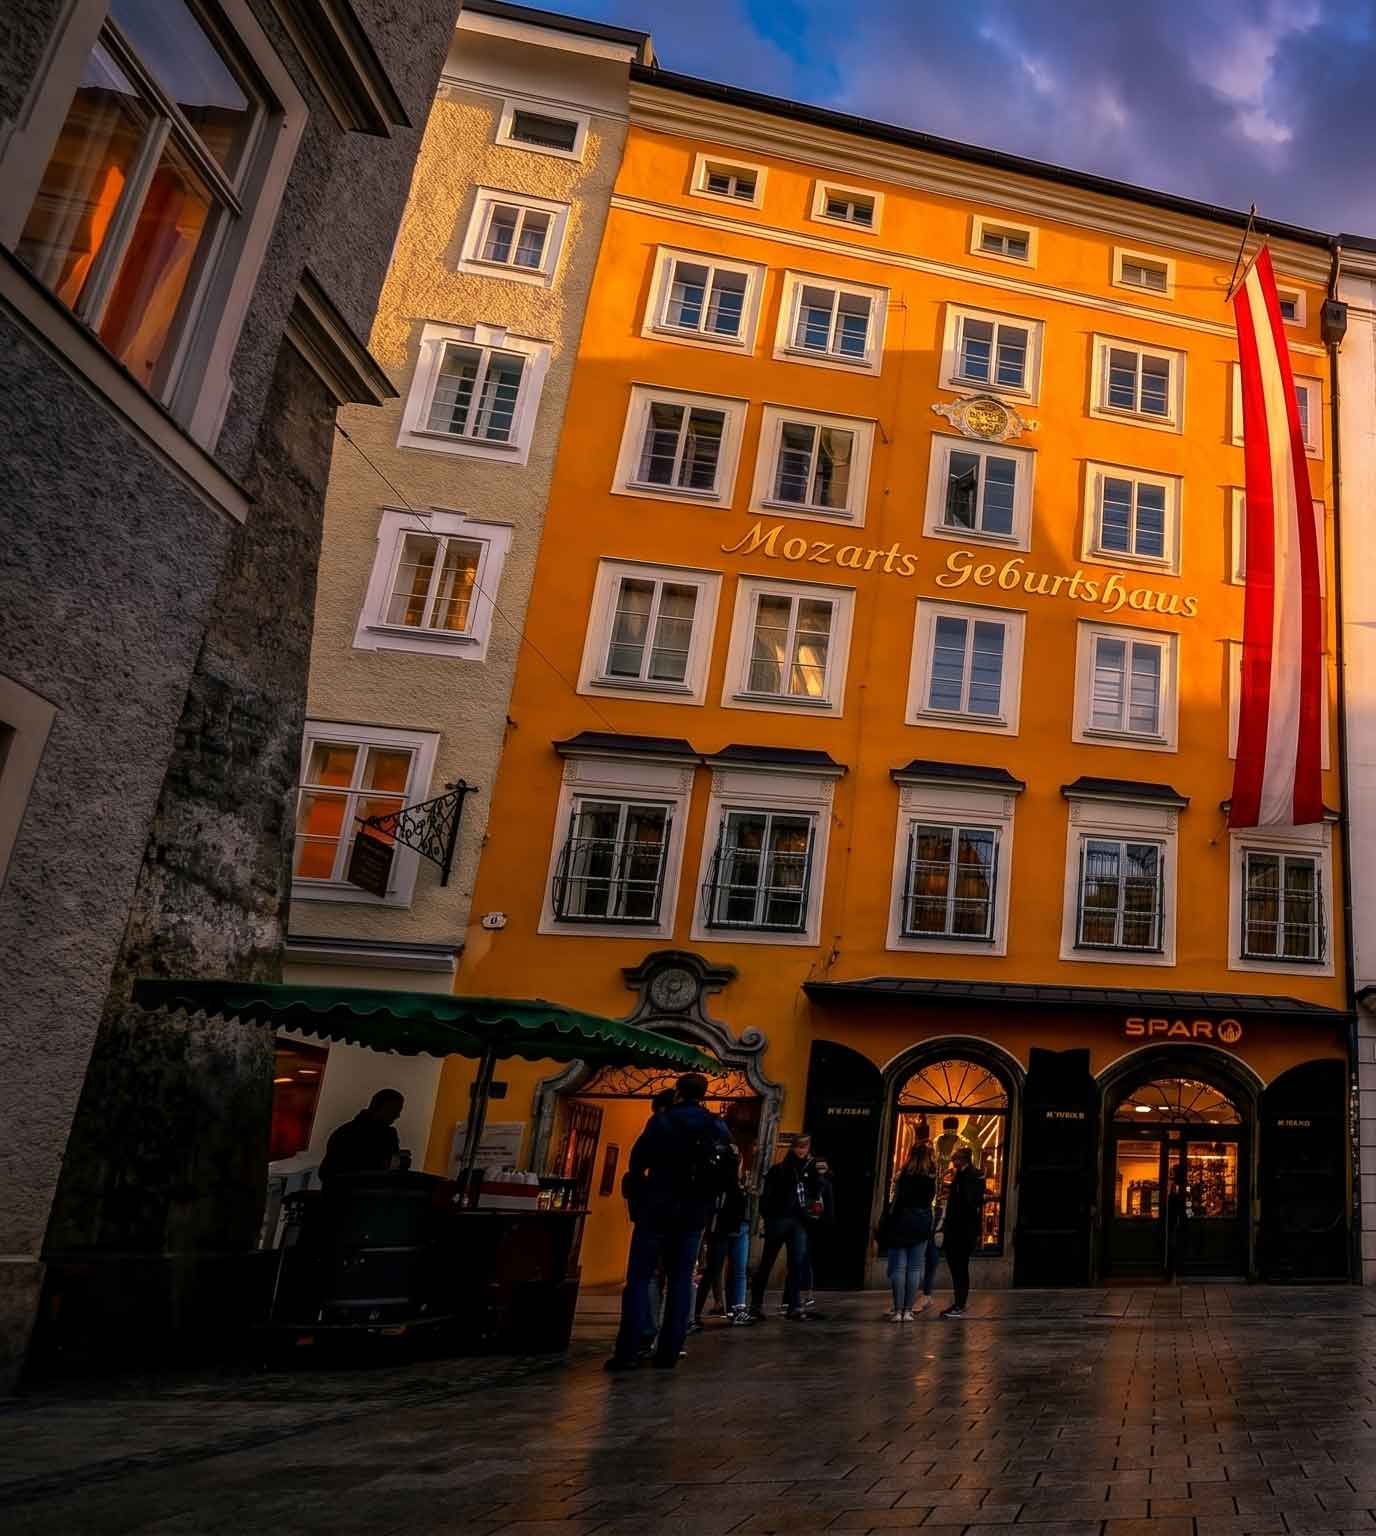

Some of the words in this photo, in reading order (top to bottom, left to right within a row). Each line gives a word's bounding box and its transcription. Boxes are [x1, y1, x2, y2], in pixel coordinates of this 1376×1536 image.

[721, 520, 919, 577] Mozarts
[935, 550, 1199, 618] Geburtshaus
[1125, 1018, 1213, 1038] SPAR
